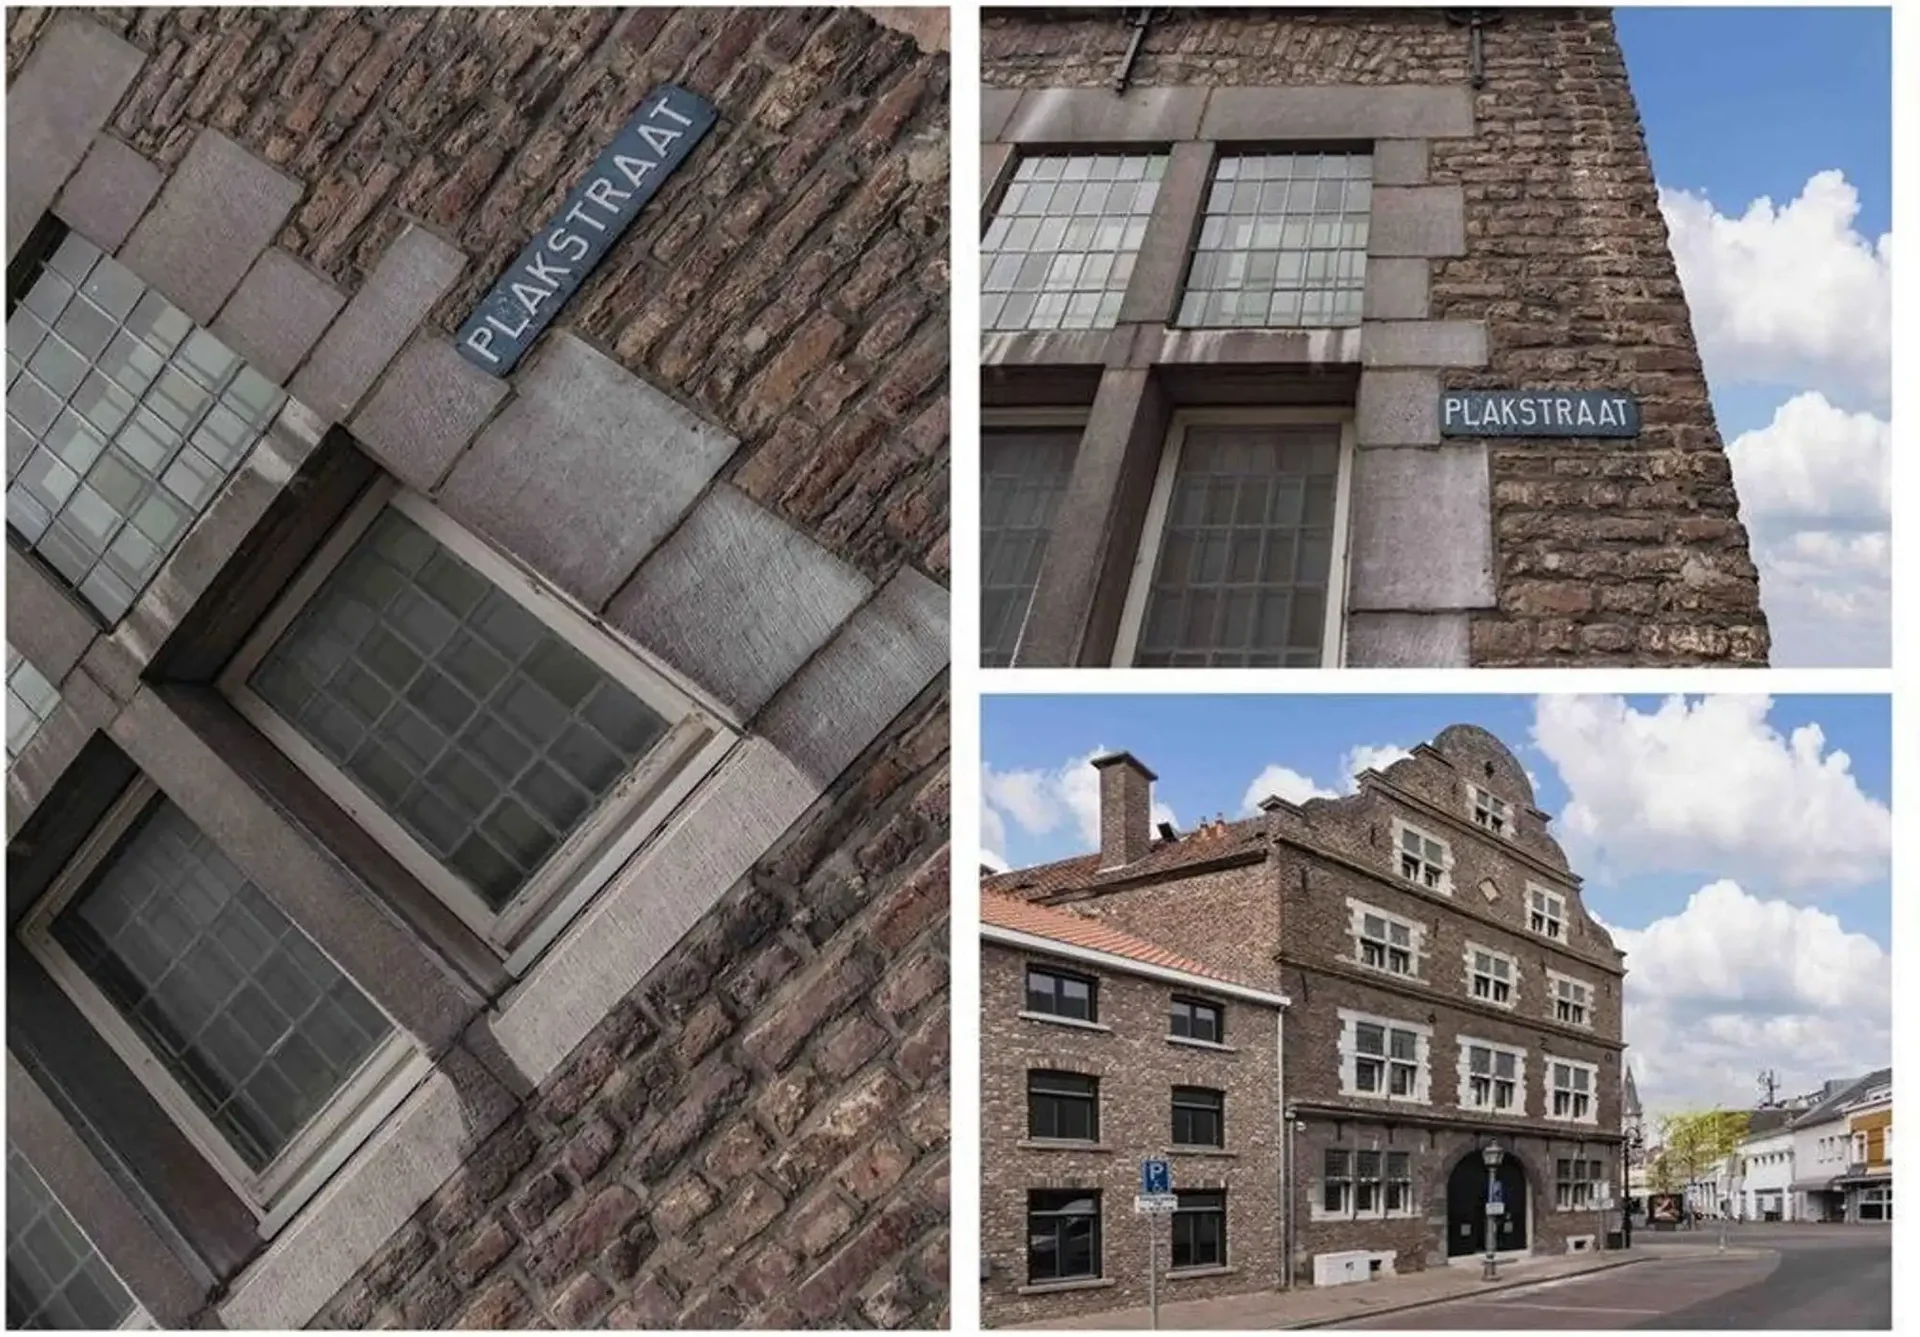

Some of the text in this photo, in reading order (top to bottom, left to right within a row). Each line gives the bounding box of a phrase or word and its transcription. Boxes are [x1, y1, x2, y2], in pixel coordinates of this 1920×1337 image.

[466, 97, 692, 363] PLAKSTRAAT
[1445, 398, 1627, 426] PLAKSTRAAT
[1150, 1161, 1164, 1181] P
